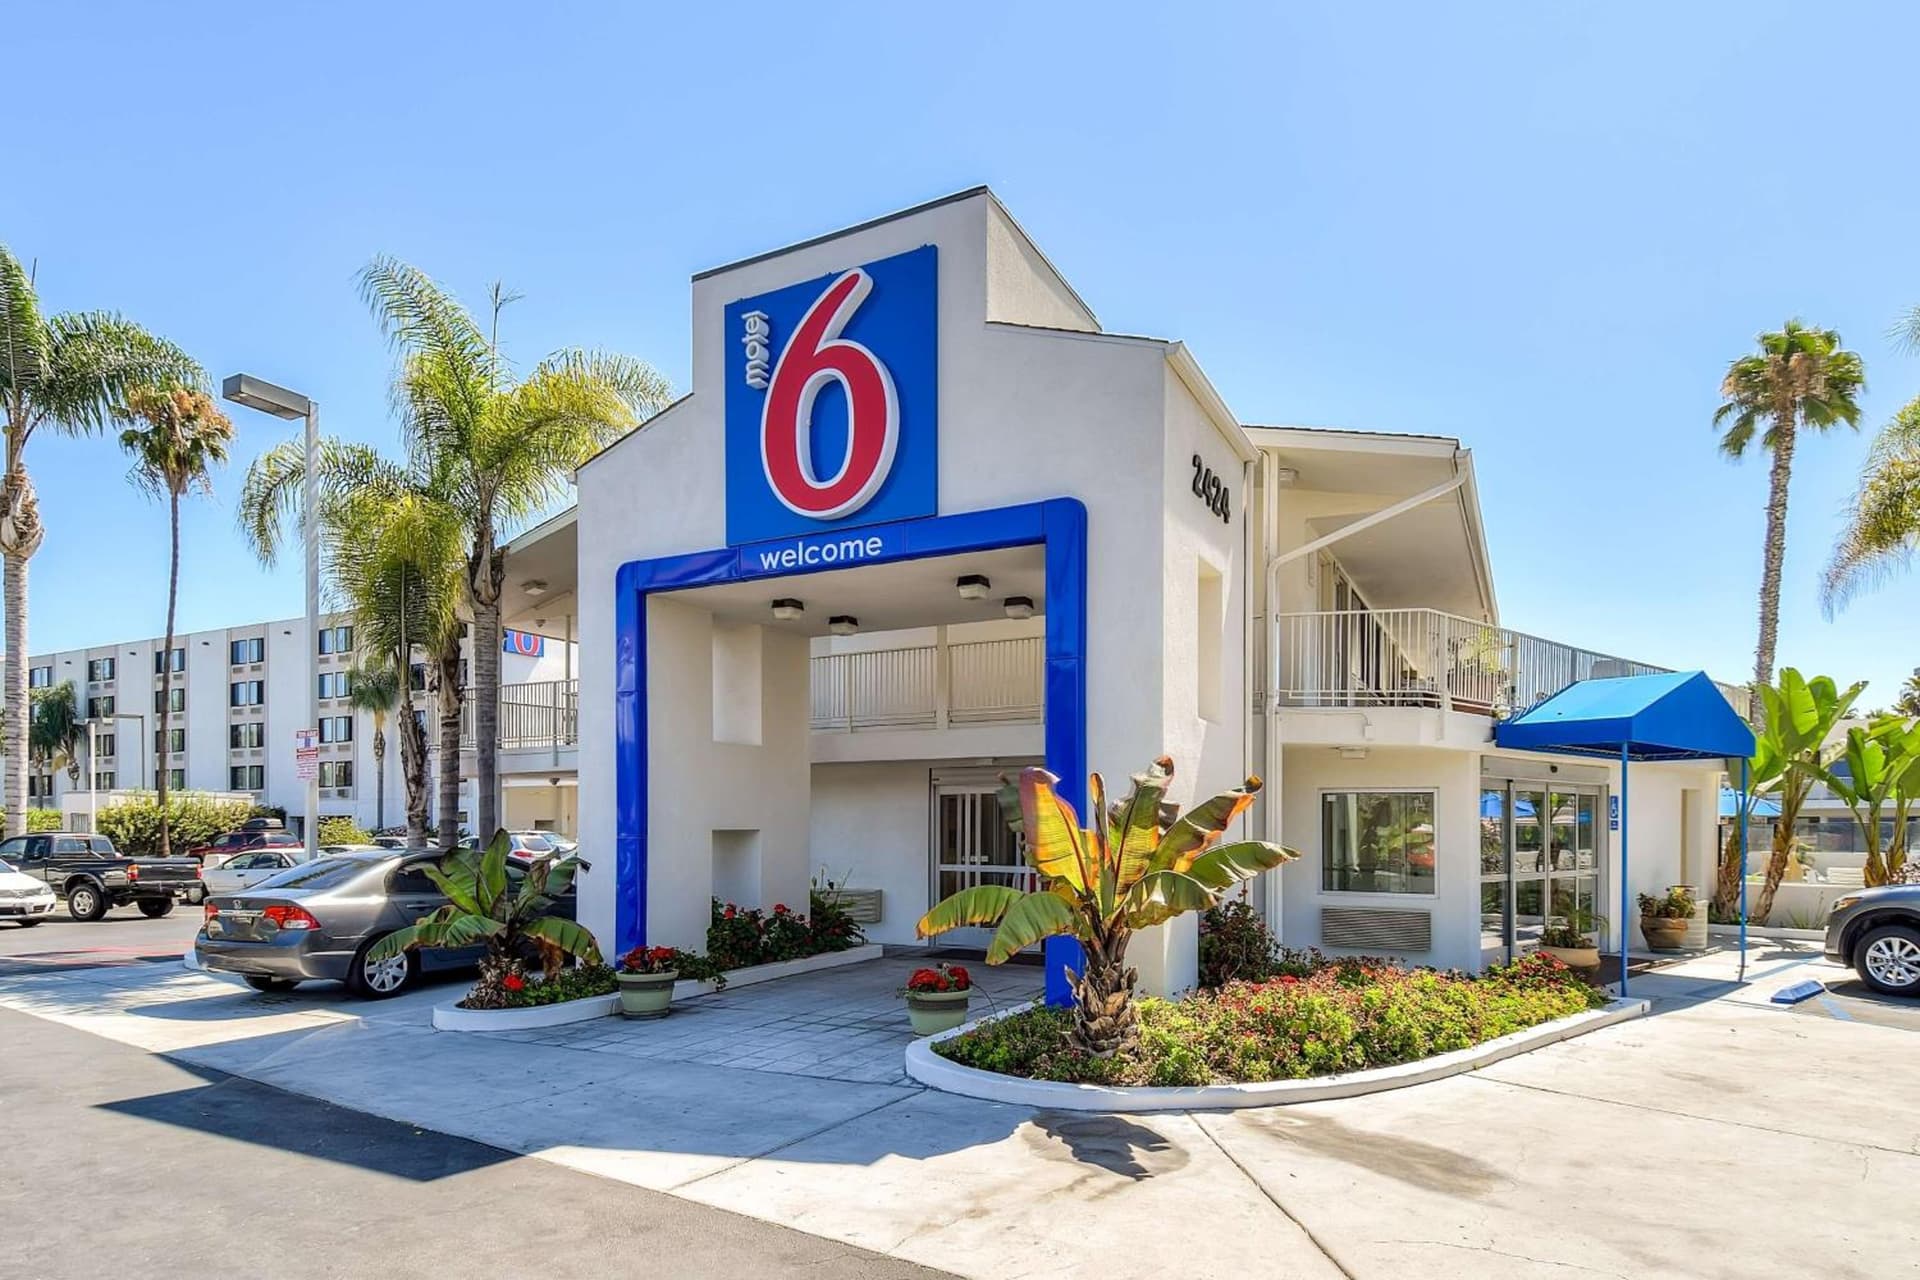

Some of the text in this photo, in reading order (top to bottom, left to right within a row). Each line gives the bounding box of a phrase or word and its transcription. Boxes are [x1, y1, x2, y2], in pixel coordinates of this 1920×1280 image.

[741, 267, 900, 521] motel 6
[1192, 454, 1231, 524] 2424
[760, 536, 883, 570] welcome
